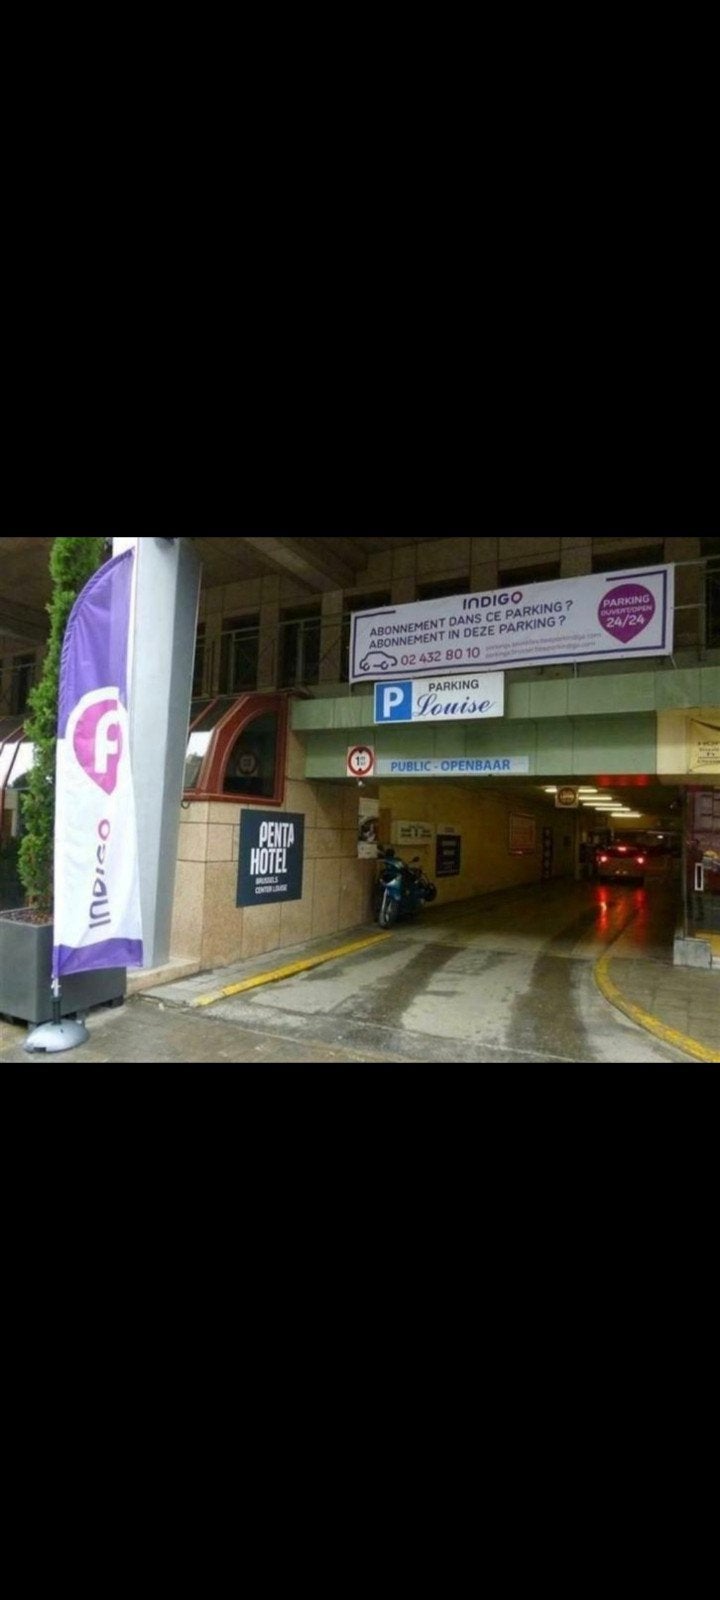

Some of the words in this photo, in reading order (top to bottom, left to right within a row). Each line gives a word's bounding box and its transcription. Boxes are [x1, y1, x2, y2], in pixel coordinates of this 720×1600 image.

[463, 591, 523, 610] INDIGO
[603, 594, 650, 608] PARKING
[370, 618, 446, 637] ABONNEMENT
[449, 614, 482, 627] DANS
[486, 611, 502, 622] CE
[505, 602, 562, 619] PARKING
[565, 600, 573, 612] ?
[606, 613, 645, 628] 24/24
[369, 631, 445, 649] ABONNEMENT
[449, 629, 459, 640] IN
[464, 625, 495, 638] DEZE
[500, 616, 556, 634] PARKING
[559, 615, 567, 627] ?
[401, 655, 416, 666] 02
[419, 651, 442, 663] 432
[446, 649, 463, 661] 80
[467, 647, 481, 659] 10
[428, 679, 479, 692] PARKING
[383, 687, 405, 718] P
[414, 693, 497, 717] Louise
[391, 760, 431, 772] PUBLIC
[441, 759, 511, 772] OPENBAAR
[259, 821, 295, 848] PENTA
[249, 848, 287, 875] HOTEL
